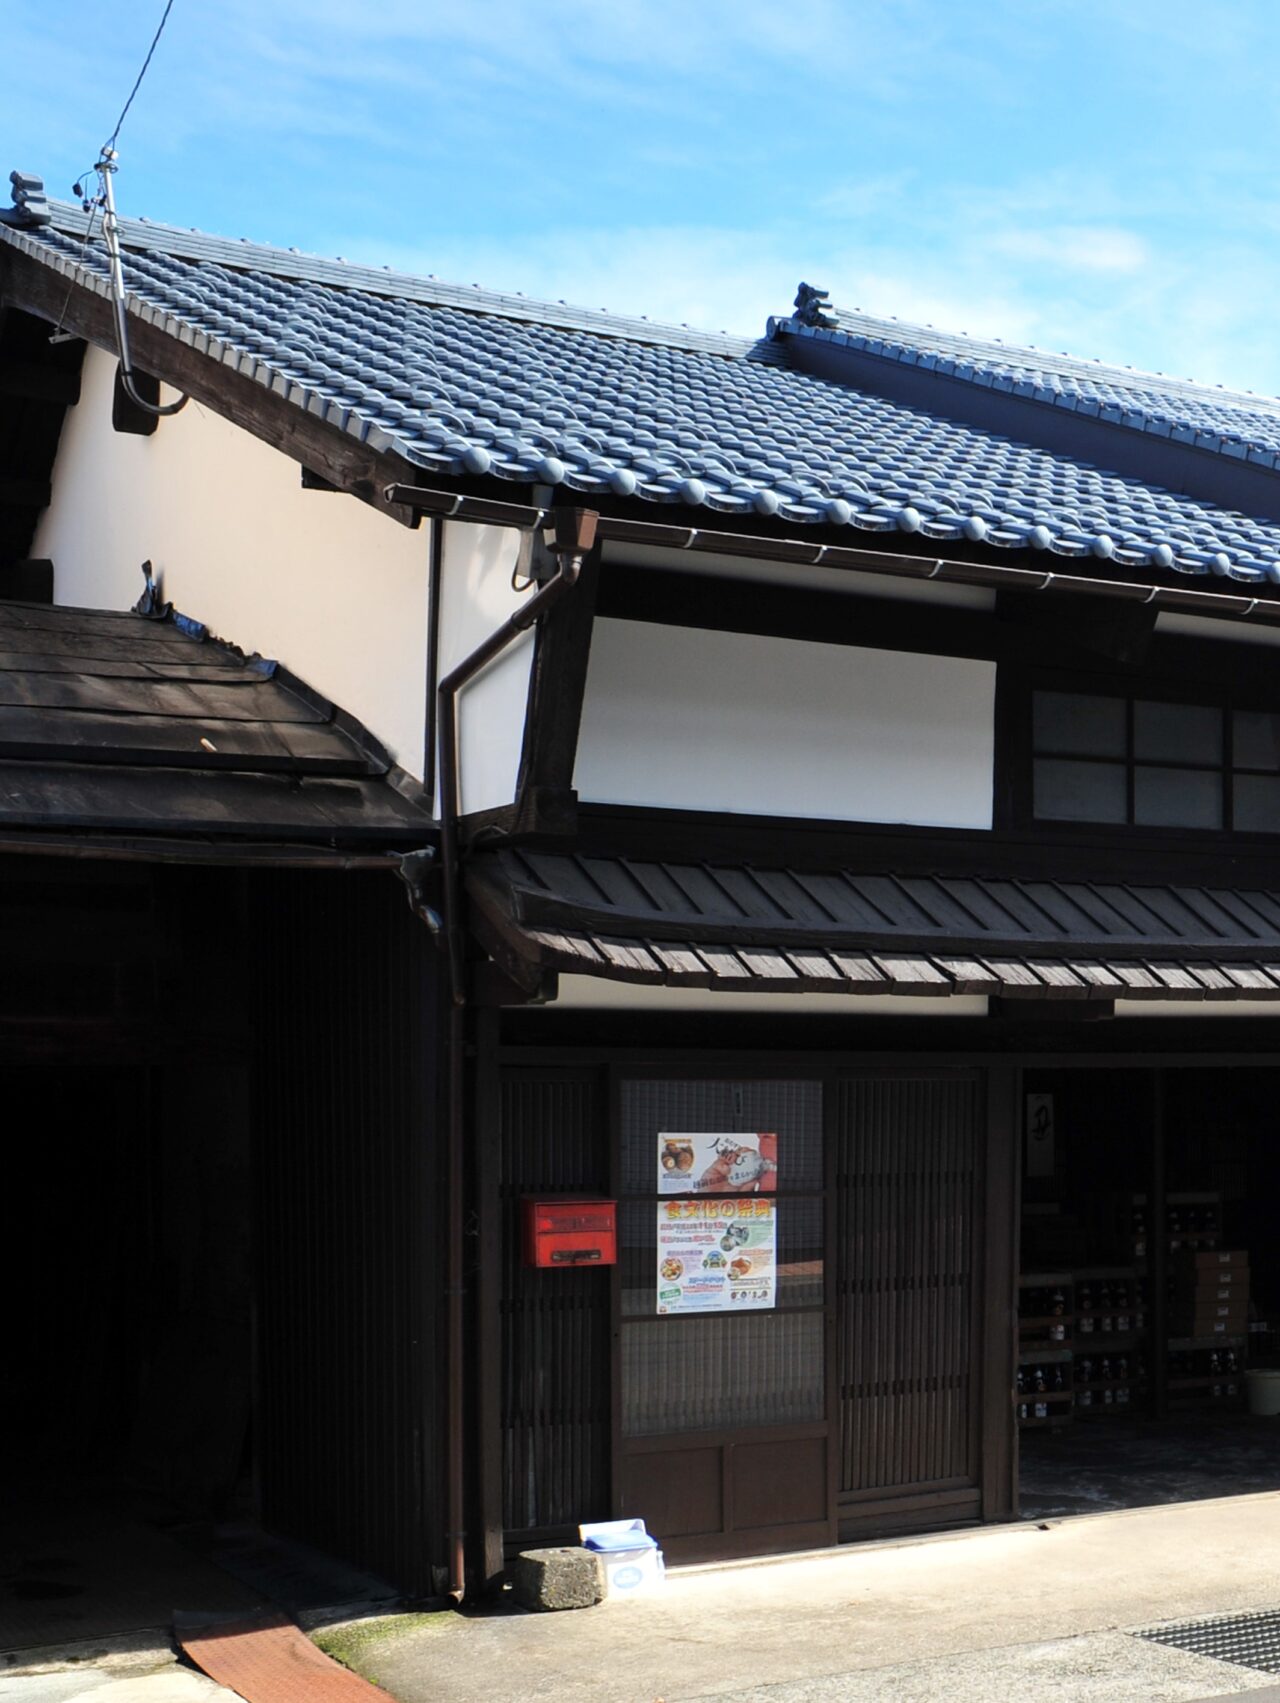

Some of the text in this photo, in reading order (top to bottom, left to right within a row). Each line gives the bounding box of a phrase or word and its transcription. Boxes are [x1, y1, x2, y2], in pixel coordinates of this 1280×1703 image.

[663, 1198, 771, 1220] 食文化の祭典
